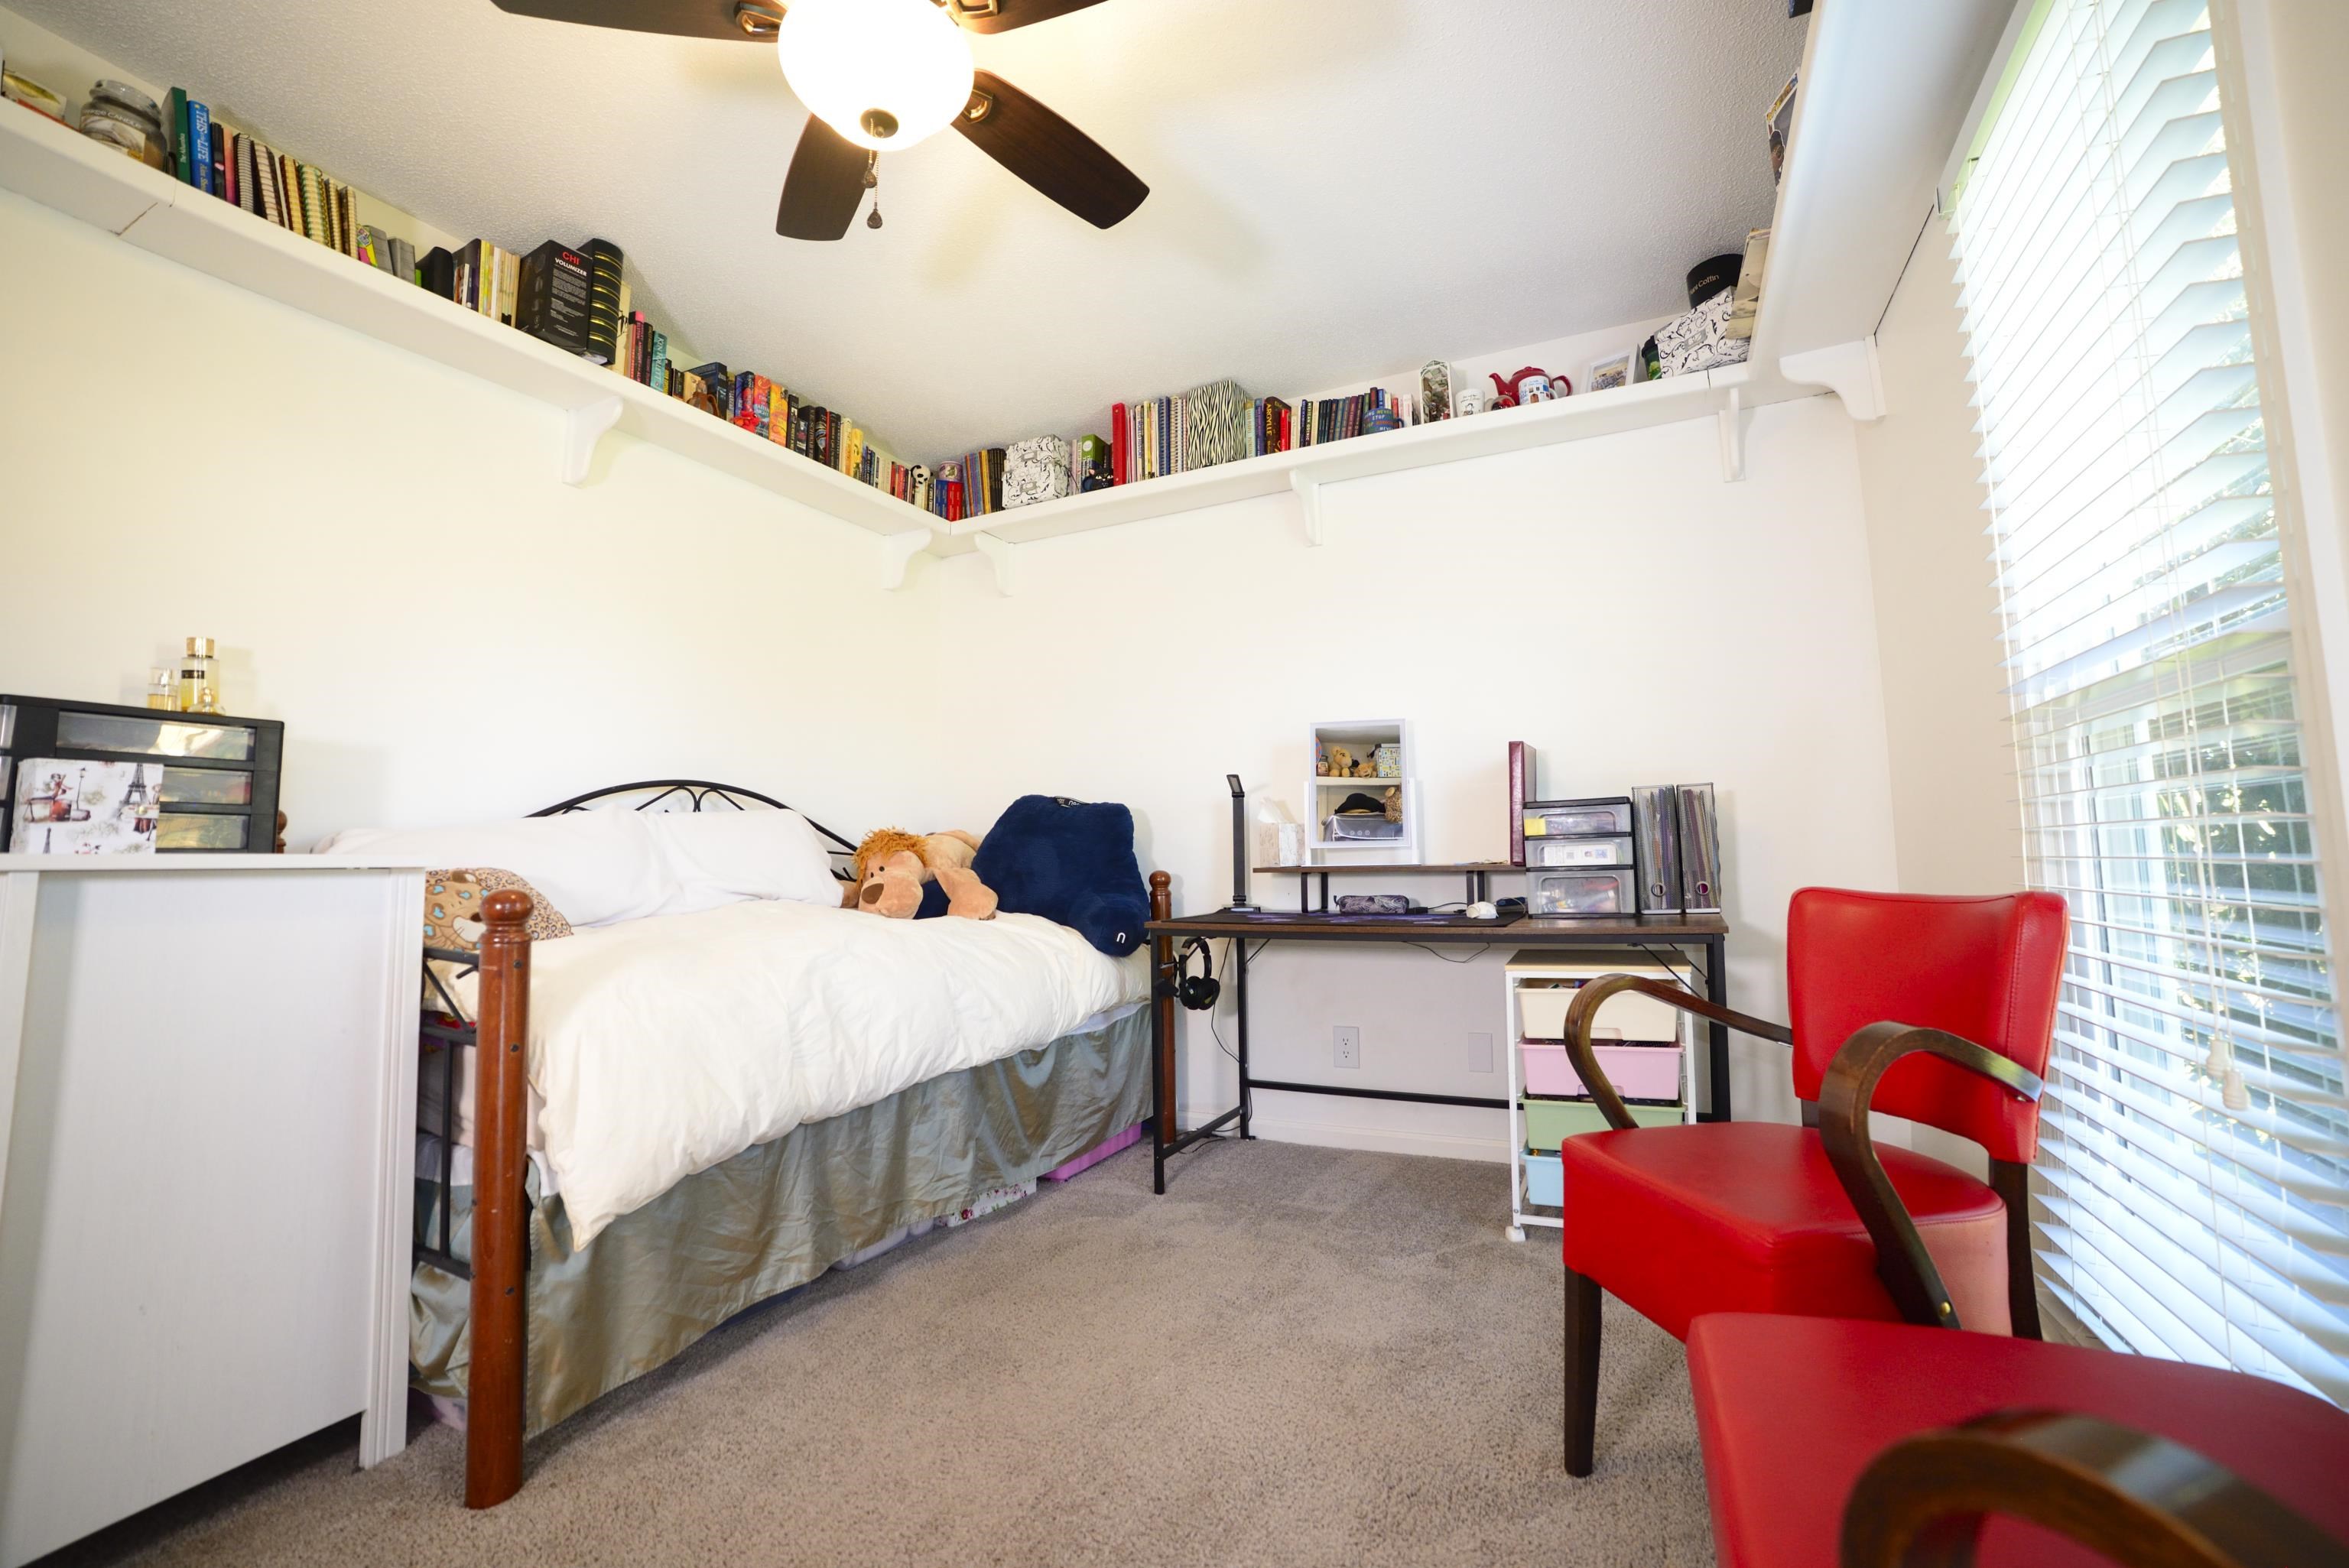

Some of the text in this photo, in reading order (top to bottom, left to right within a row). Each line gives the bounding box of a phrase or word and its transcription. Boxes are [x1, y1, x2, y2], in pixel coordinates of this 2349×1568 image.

[196, 109, 208, 134] THIS
[197, 138, 210, 162] LIFE
[554, 257, 587, 278] VOLUMIZER
[562, 252, 580, 265] CHI
[1698, 274, 1720, 287] Coffin
[655, 352, 663, 381] FOLLETT
